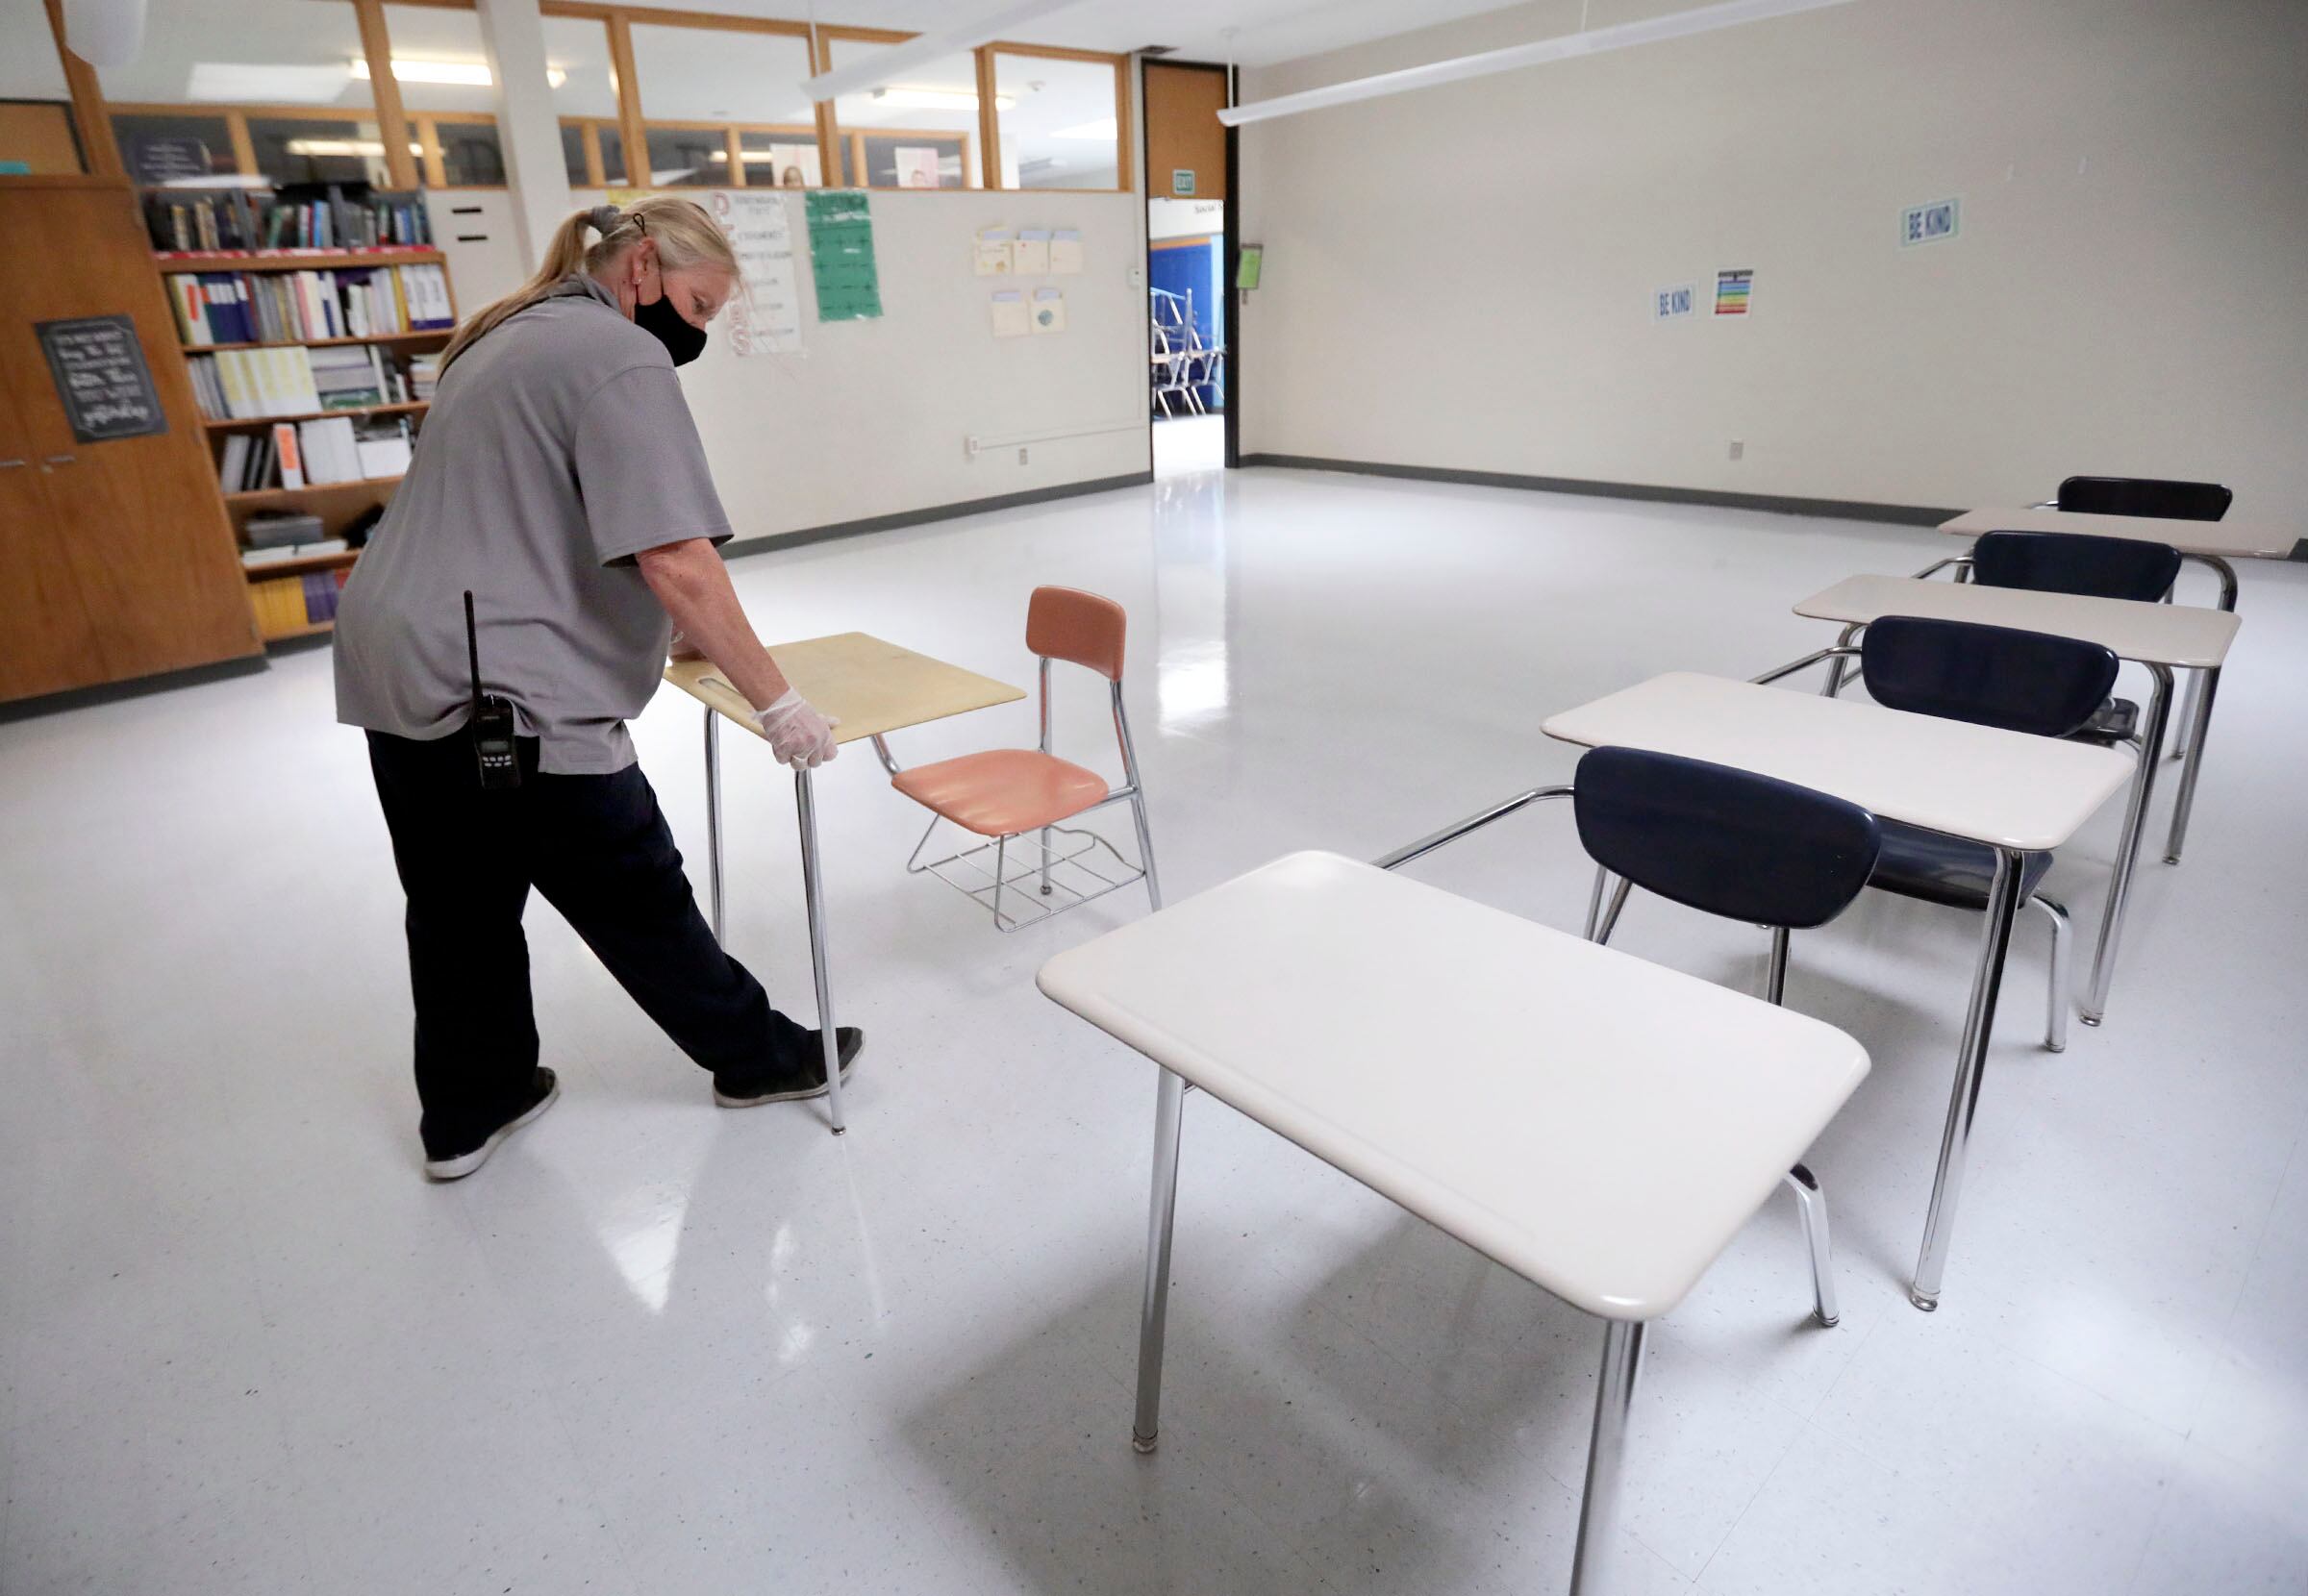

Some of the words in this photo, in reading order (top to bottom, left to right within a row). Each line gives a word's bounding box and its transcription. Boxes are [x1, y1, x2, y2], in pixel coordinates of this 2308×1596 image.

[1909, 212, 1922, 240] BE
[1924, 205, 1951, 237] KIND
[1660, 292, 1669, 316] BE
[1671, 288, 1691, 314] KIND
